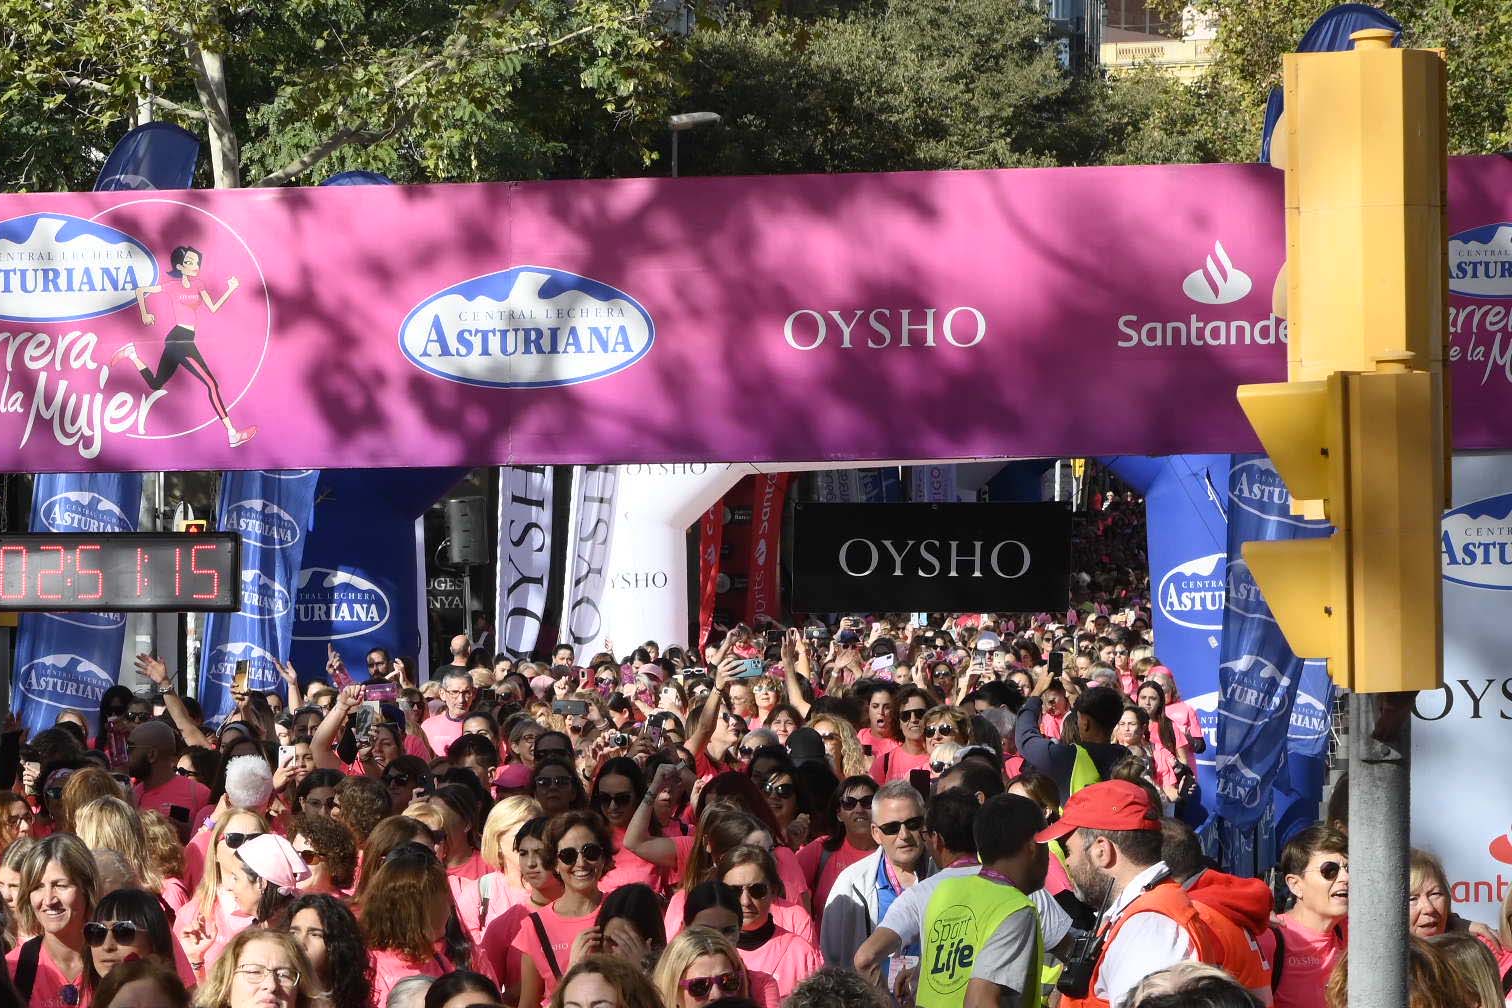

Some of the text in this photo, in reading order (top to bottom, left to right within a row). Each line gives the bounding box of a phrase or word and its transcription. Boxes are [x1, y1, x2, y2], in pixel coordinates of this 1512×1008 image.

[61, 249, 134, 261] LECHERA
[458, 306, 626, 321] CENTRAL LECHERA
[783, 306, 987, 351] OYSHO
[419, 312, 634, 358] ASTURIANA
[1467, 334, 1485, 361] la
[0, 374, 24, 414] la
[20, 366, 168, 459] Mujer
[0, 544, 220, 599] 02:51:15
[838, 538, 1031, 579] OYSHO
[609, 570, 668, 589] YSHO
[429, 596, 463, 609] NYA
[25, 668, 105, 701] ASTURIAN
[1289, 712, 1326, 732] RIANA
[930, 917, 972, 944] Sport
[930, 939, 974, 980] Life
